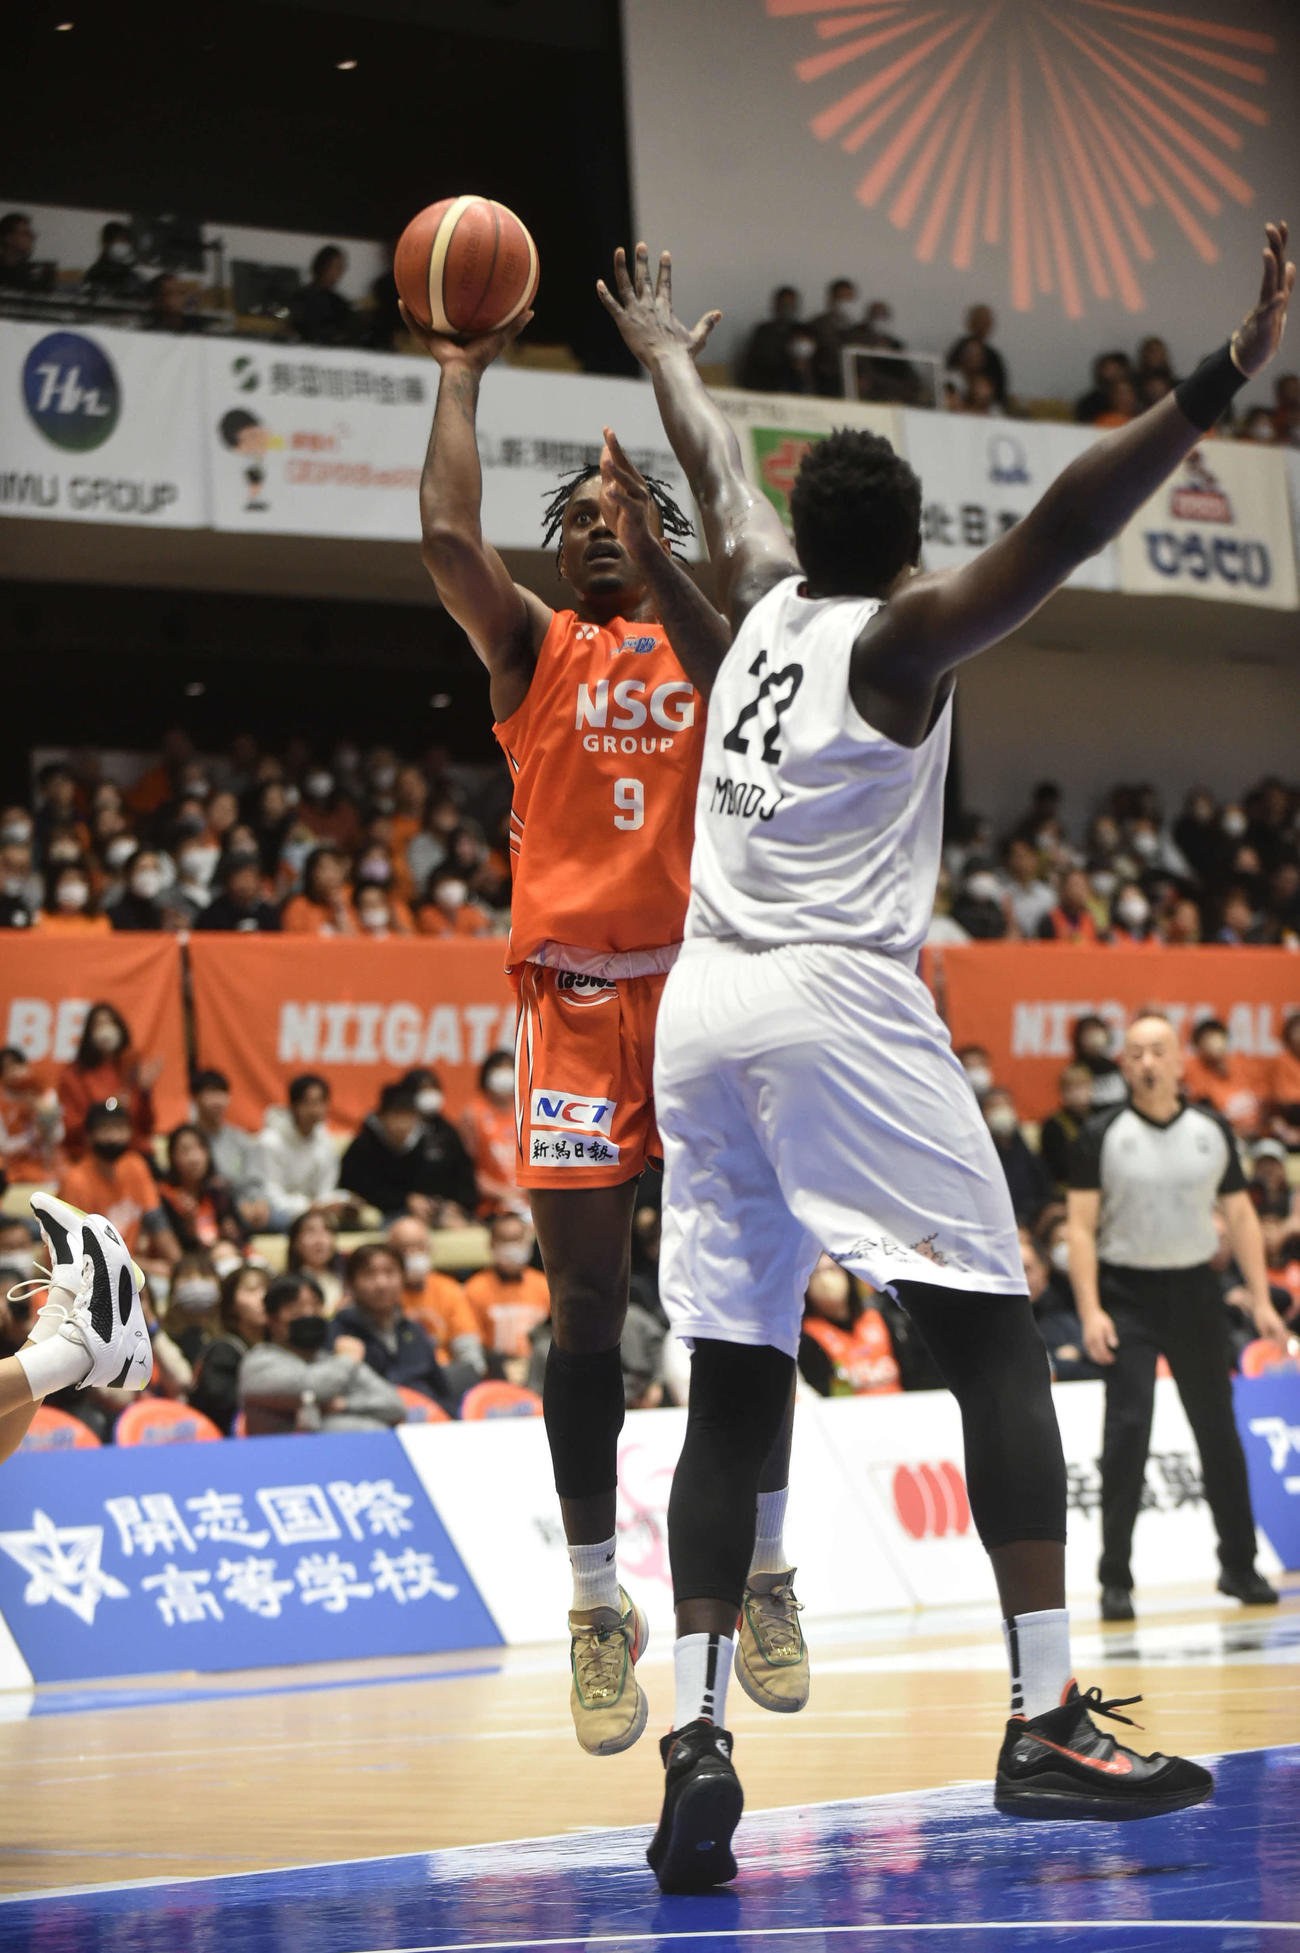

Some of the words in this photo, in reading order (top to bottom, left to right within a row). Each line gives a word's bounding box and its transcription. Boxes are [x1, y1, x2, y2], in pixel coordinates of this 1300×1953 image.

[68, 475, 180, 515] GROUP
[575, 679, 696, 732] NSG
[582, 734, 675, 754] GROUP
[613, 777, 645, 831] 9
[536, 1097, 609, 1124] NCT
[532, 1138, 613, 1162] 新潟日報
[104, 1479, 415, 1557] 開志国際
[141, 1547, 460, 1627] 高等学校
